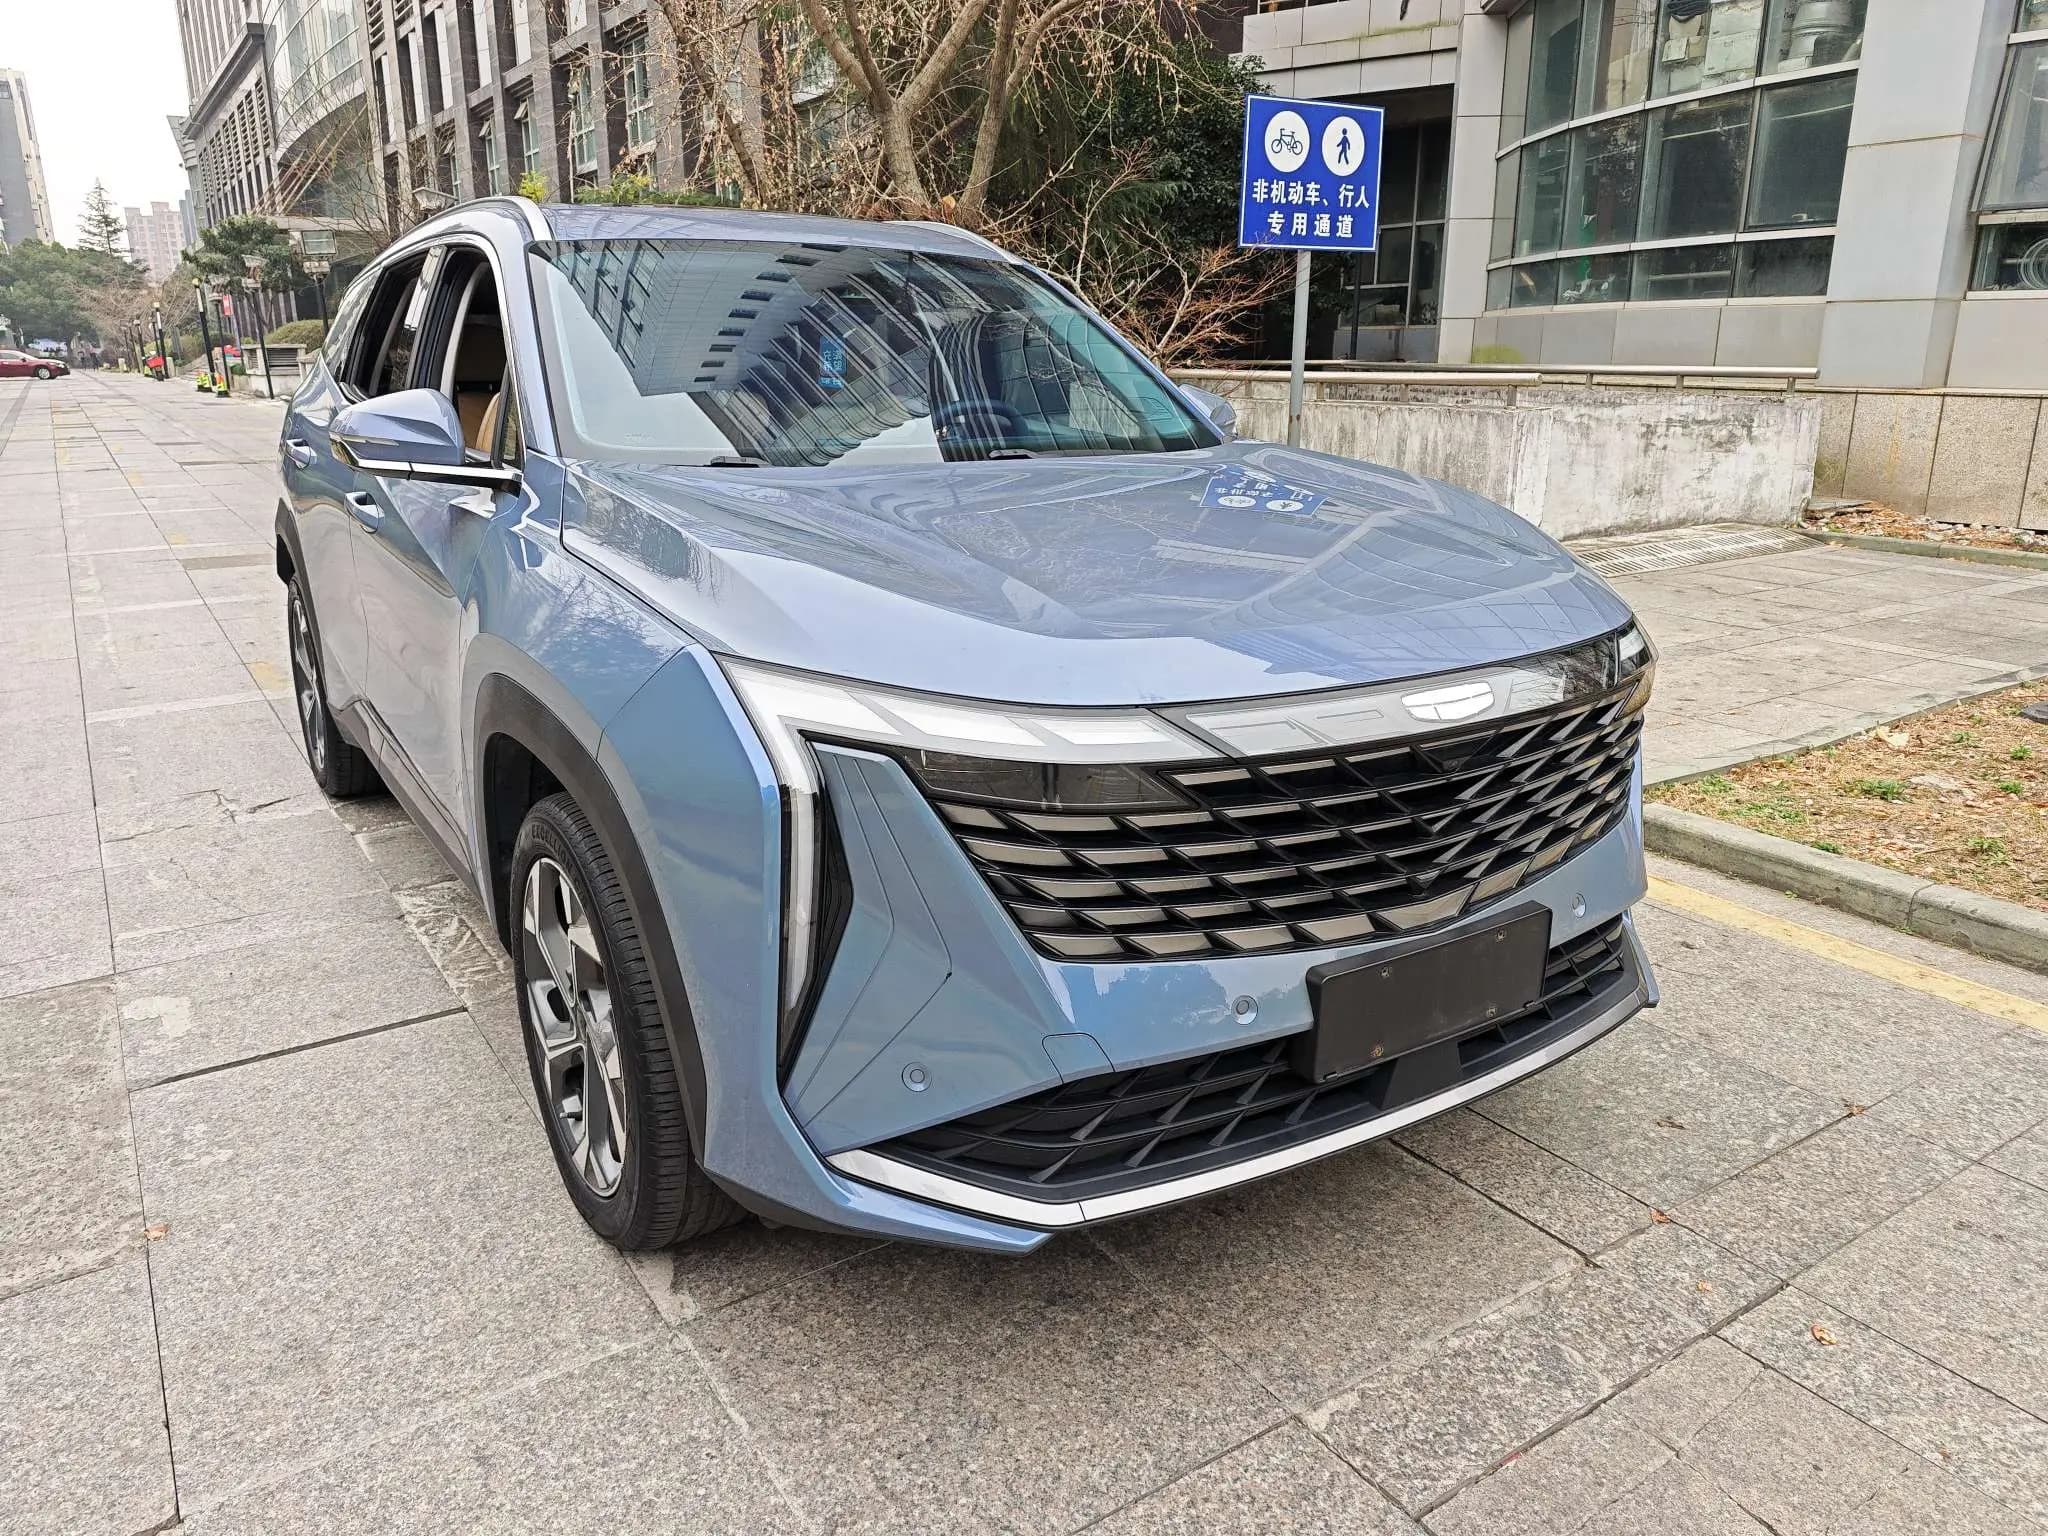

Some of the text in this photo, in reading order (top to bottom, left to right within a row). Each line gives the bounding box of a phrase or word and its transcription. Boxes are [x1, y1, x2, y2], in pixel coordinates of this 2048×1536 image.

[1252, 178, 1370, 209] 非机动车、行人
[1267, 211, 1354, 238] 专用通道
